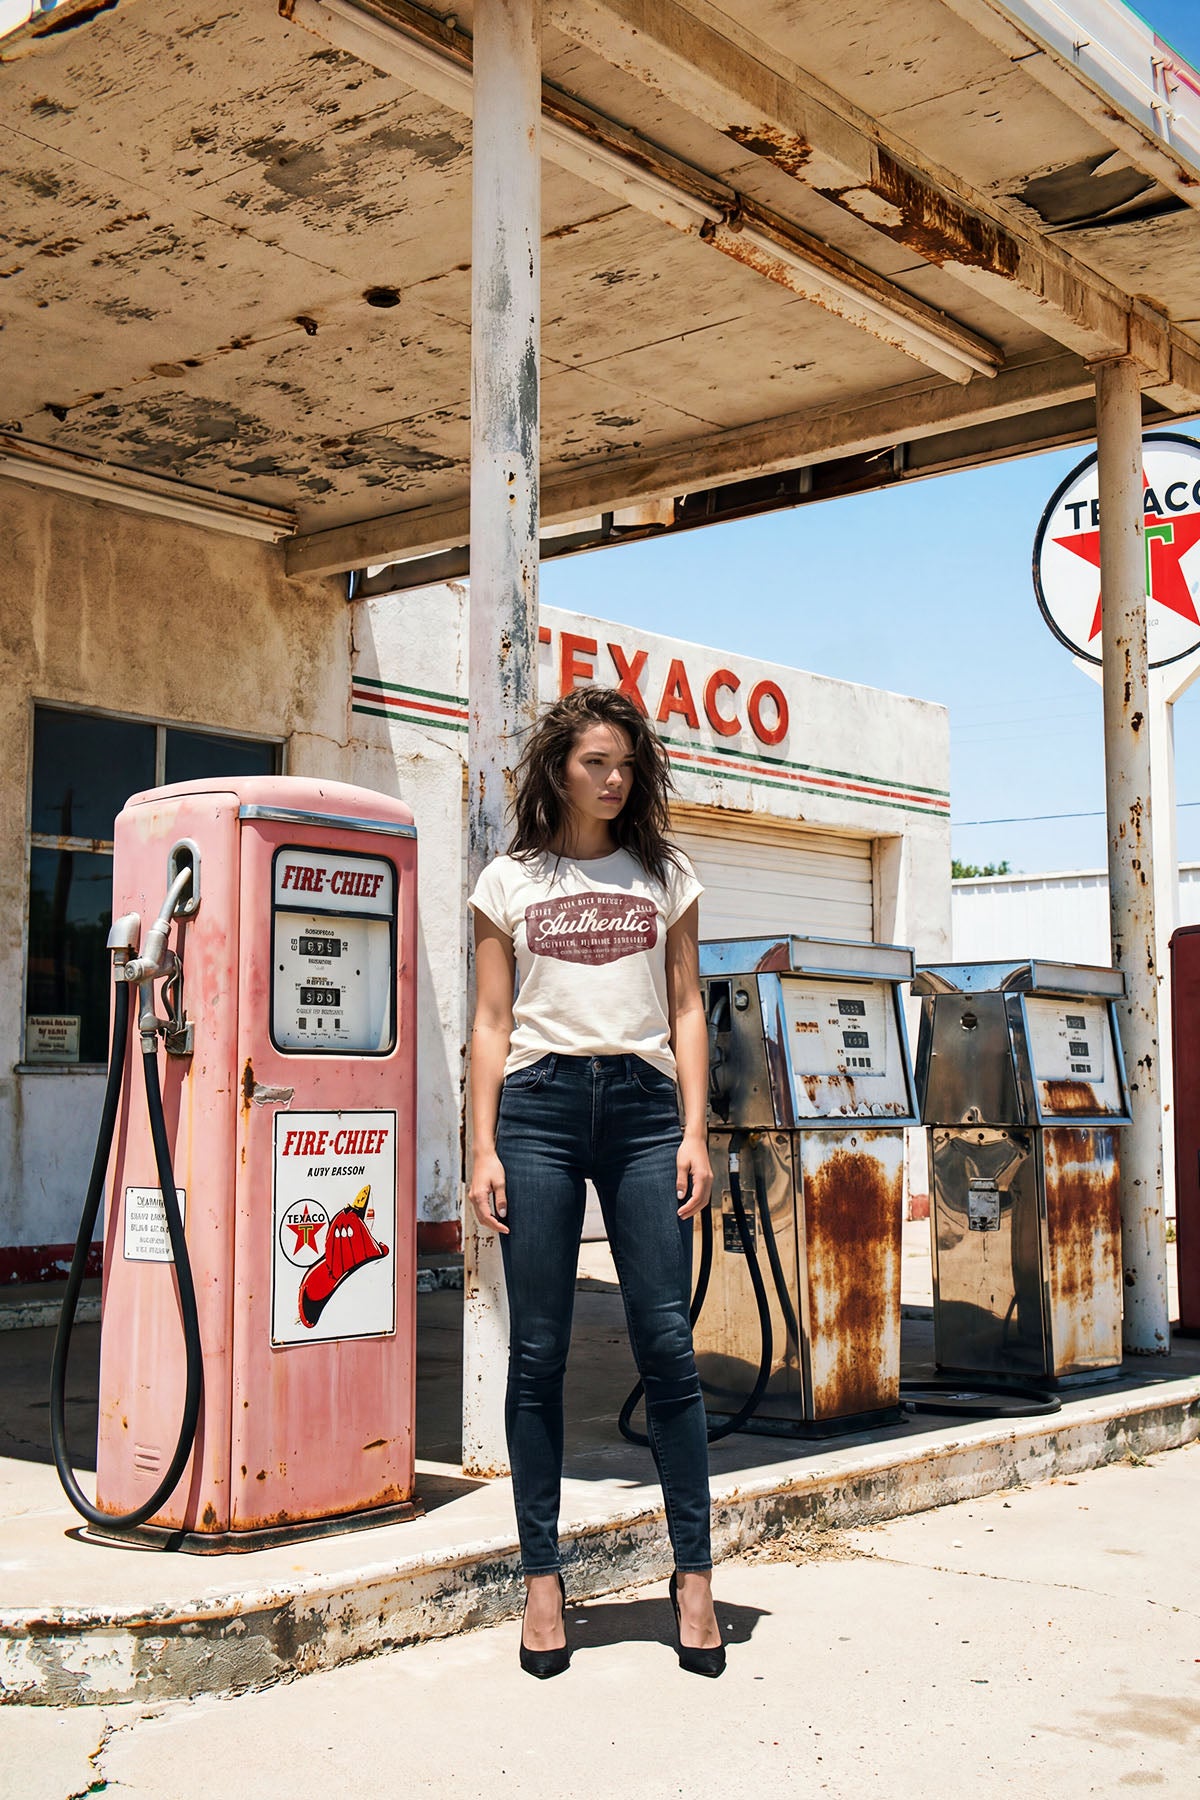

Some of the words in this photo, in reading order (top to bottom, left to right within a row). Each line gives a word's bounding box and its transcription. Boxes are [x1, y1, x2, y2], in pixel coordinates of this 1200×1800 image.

[1064, 480, 1200, 530] TEAC
[539, 626, 790, 746] EXACO
[281, 865, 385, 898] FIRE-CHIEF
[535, 908, 651, 942] Authentic
[288, 1213, 326, 1224] TEXACO
